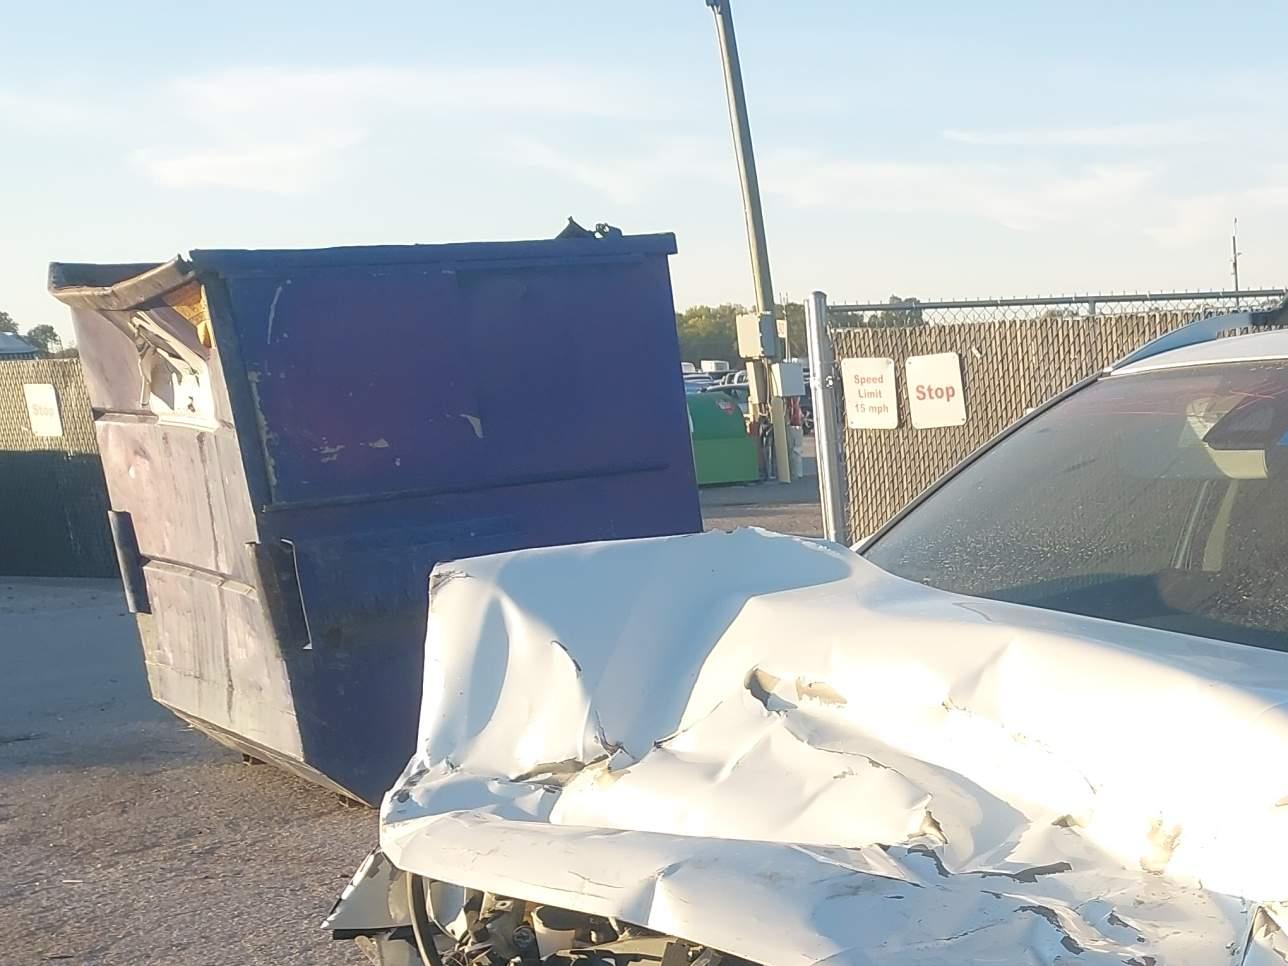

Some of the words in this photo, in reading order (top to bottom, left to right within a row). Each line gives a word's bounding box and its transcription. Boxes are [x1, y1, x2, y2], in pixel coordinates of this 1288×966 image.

[854, 374, 884, 386] Speed
[858, 389, 882, 399] Limit
[916, 384, 955, 402] Stop
[856, 403, 865, 413] 15
[869, 404, 889, 415] mph
